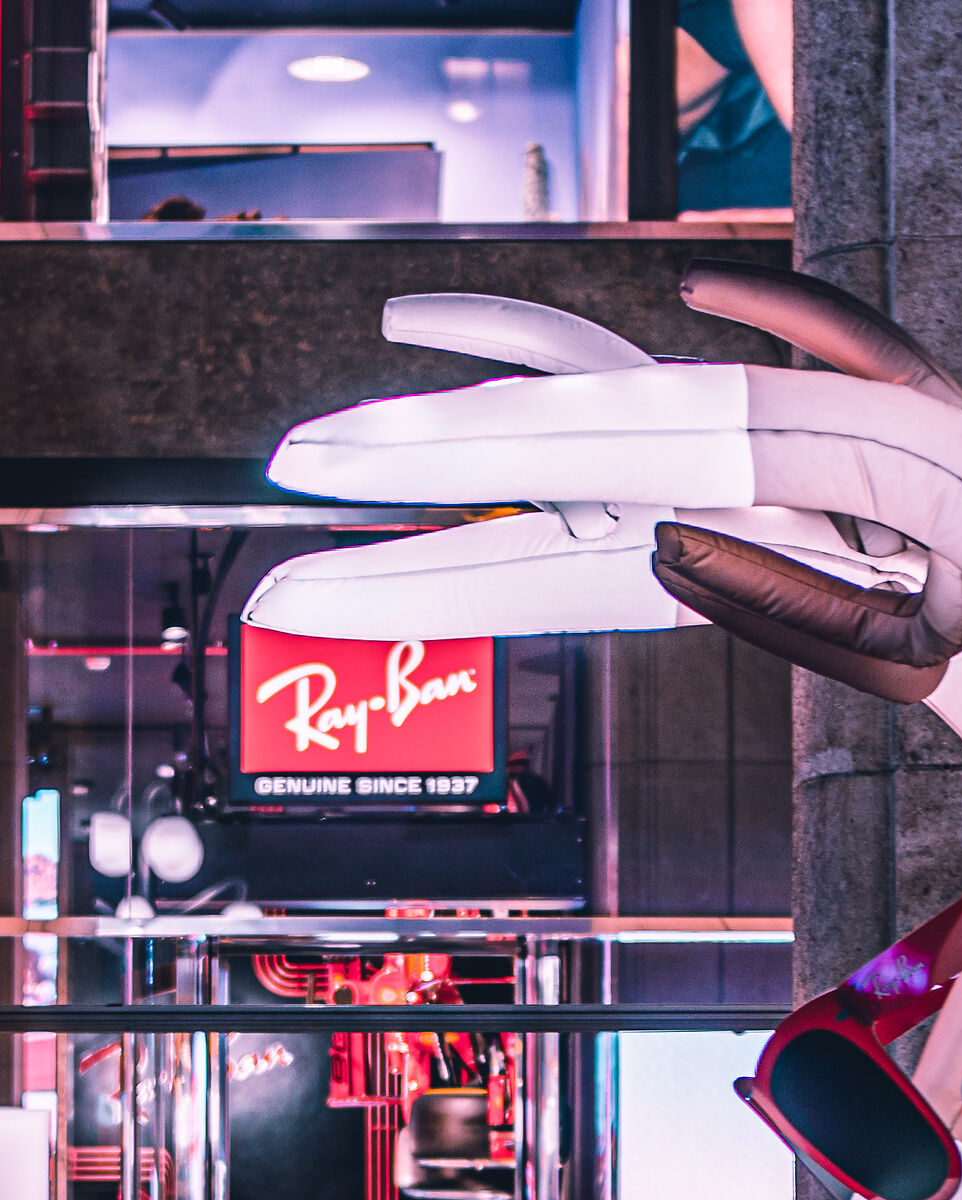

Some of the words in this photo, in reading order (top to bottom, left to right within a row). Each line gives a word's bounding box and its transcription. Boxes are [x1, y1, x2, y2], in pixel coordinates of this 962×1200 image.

[254, 776, 351, 796] GENUINE
[355, 776, 422, 796] SINCE
[426, 776, 479, 795] 1937
